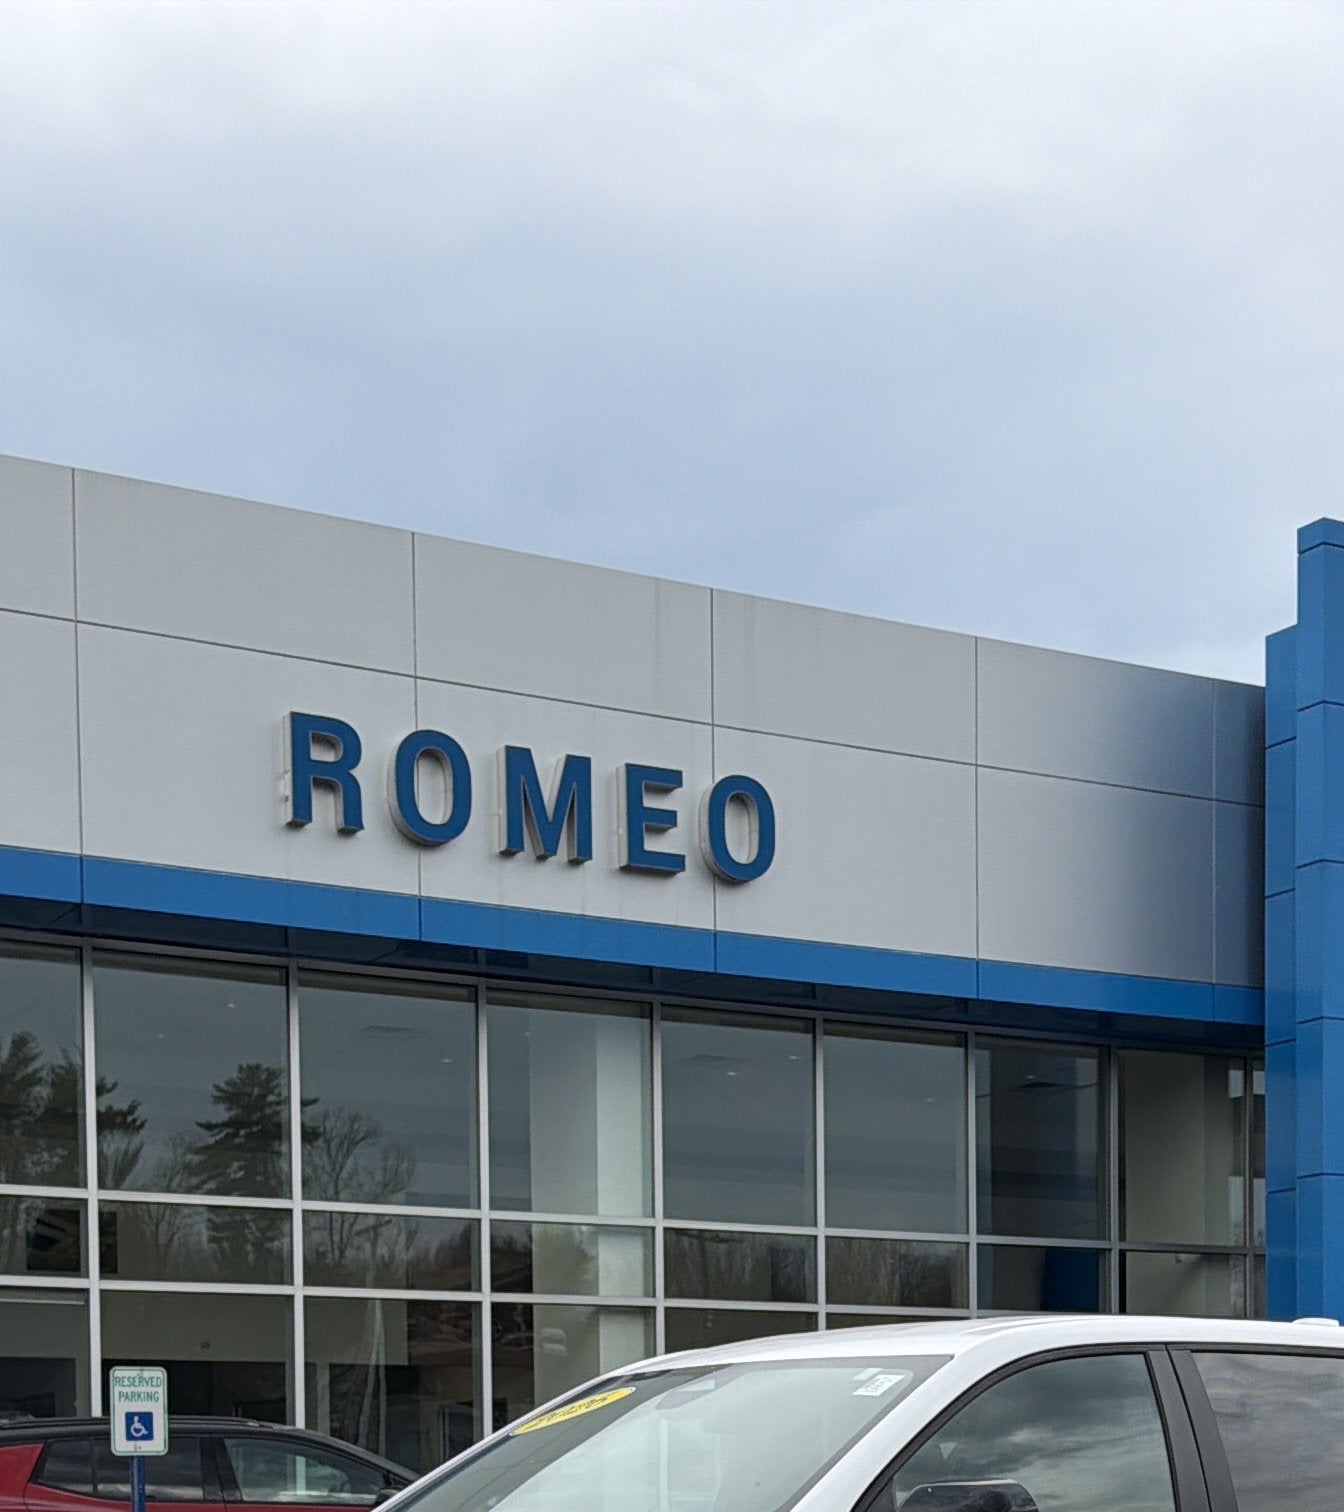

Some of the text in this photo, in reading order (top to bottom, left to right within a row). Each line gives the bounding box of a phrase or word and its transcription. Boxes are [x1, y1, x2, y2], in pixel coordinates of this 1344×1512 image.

[284, 711, 776, 883] ROMEO
[113, 1376, 162, 1387] RESERVED
[118, 1391, 160, 1402] PARKING
